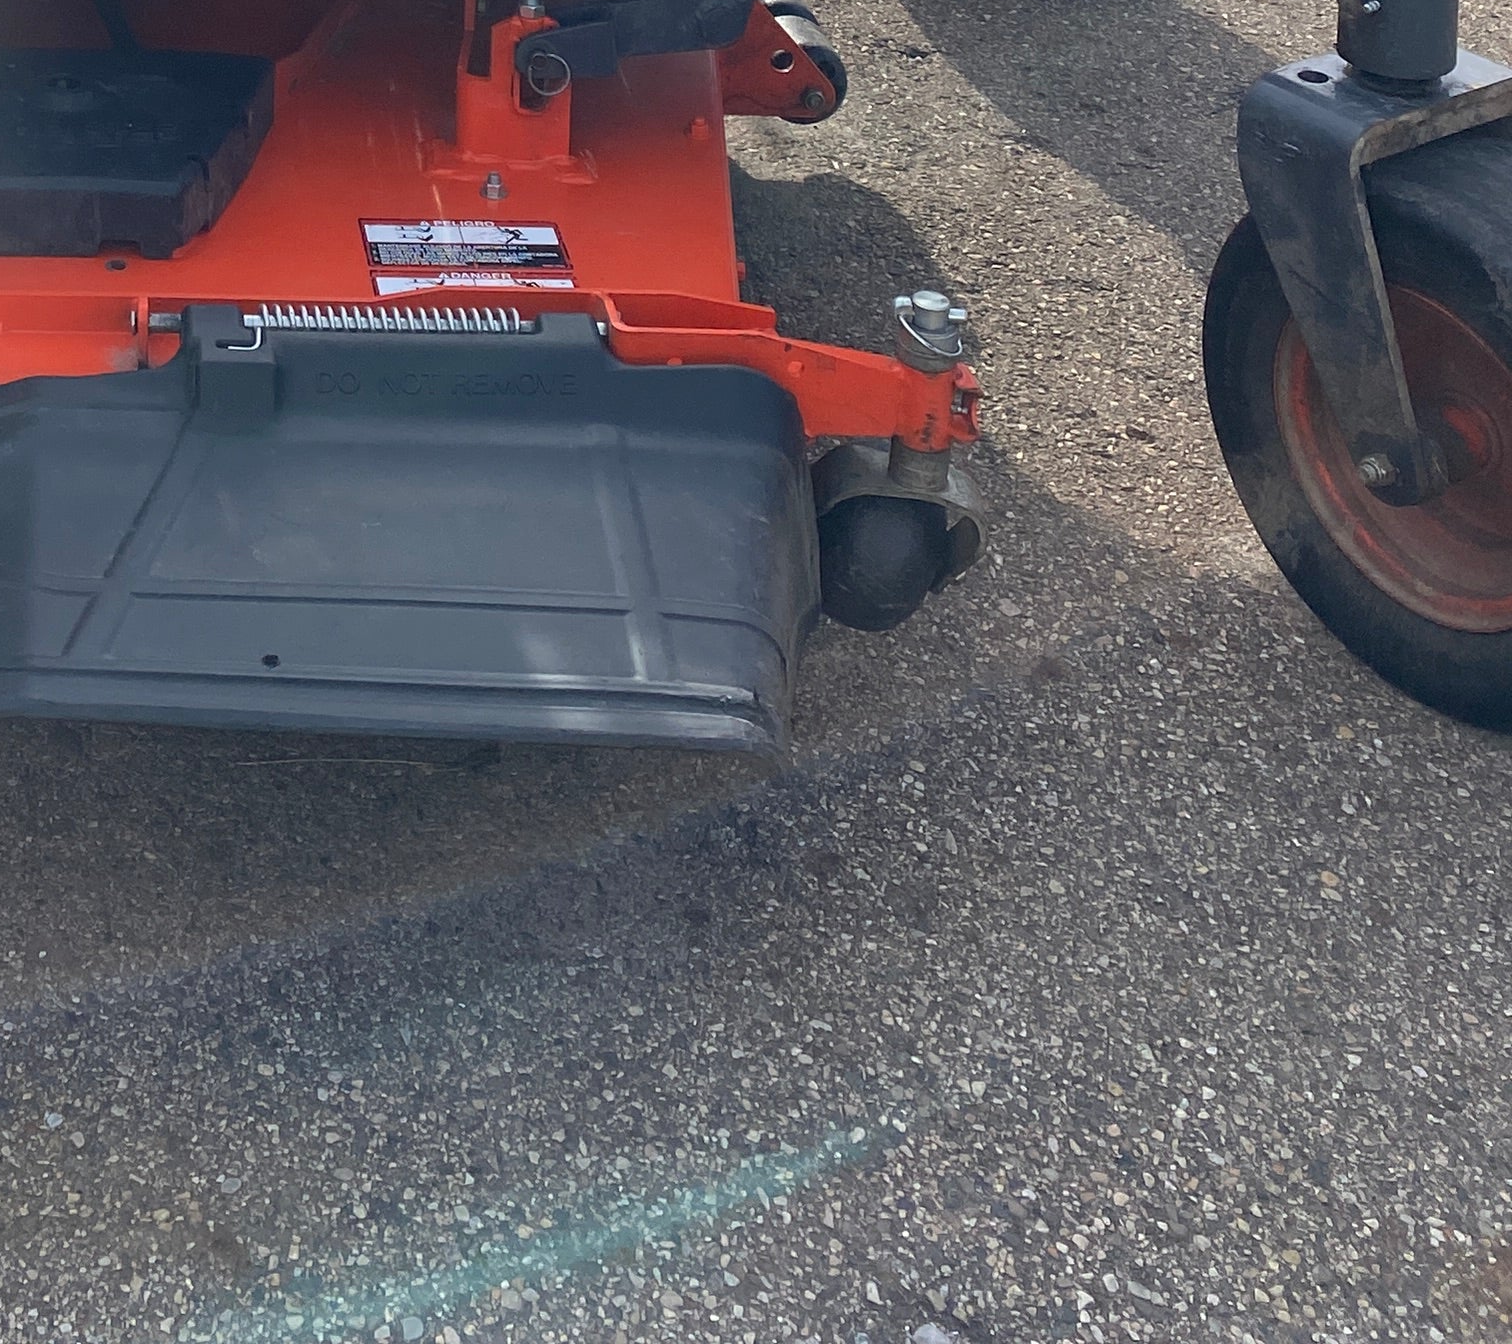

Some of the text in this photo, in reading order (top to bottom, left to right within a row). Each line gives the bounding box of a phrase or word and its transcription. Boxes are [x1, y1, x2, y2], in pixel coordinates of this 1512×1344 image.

[450, 272, 512, 280] DANGER
[316, 372, 577, 397] DO NOT REMOVE
